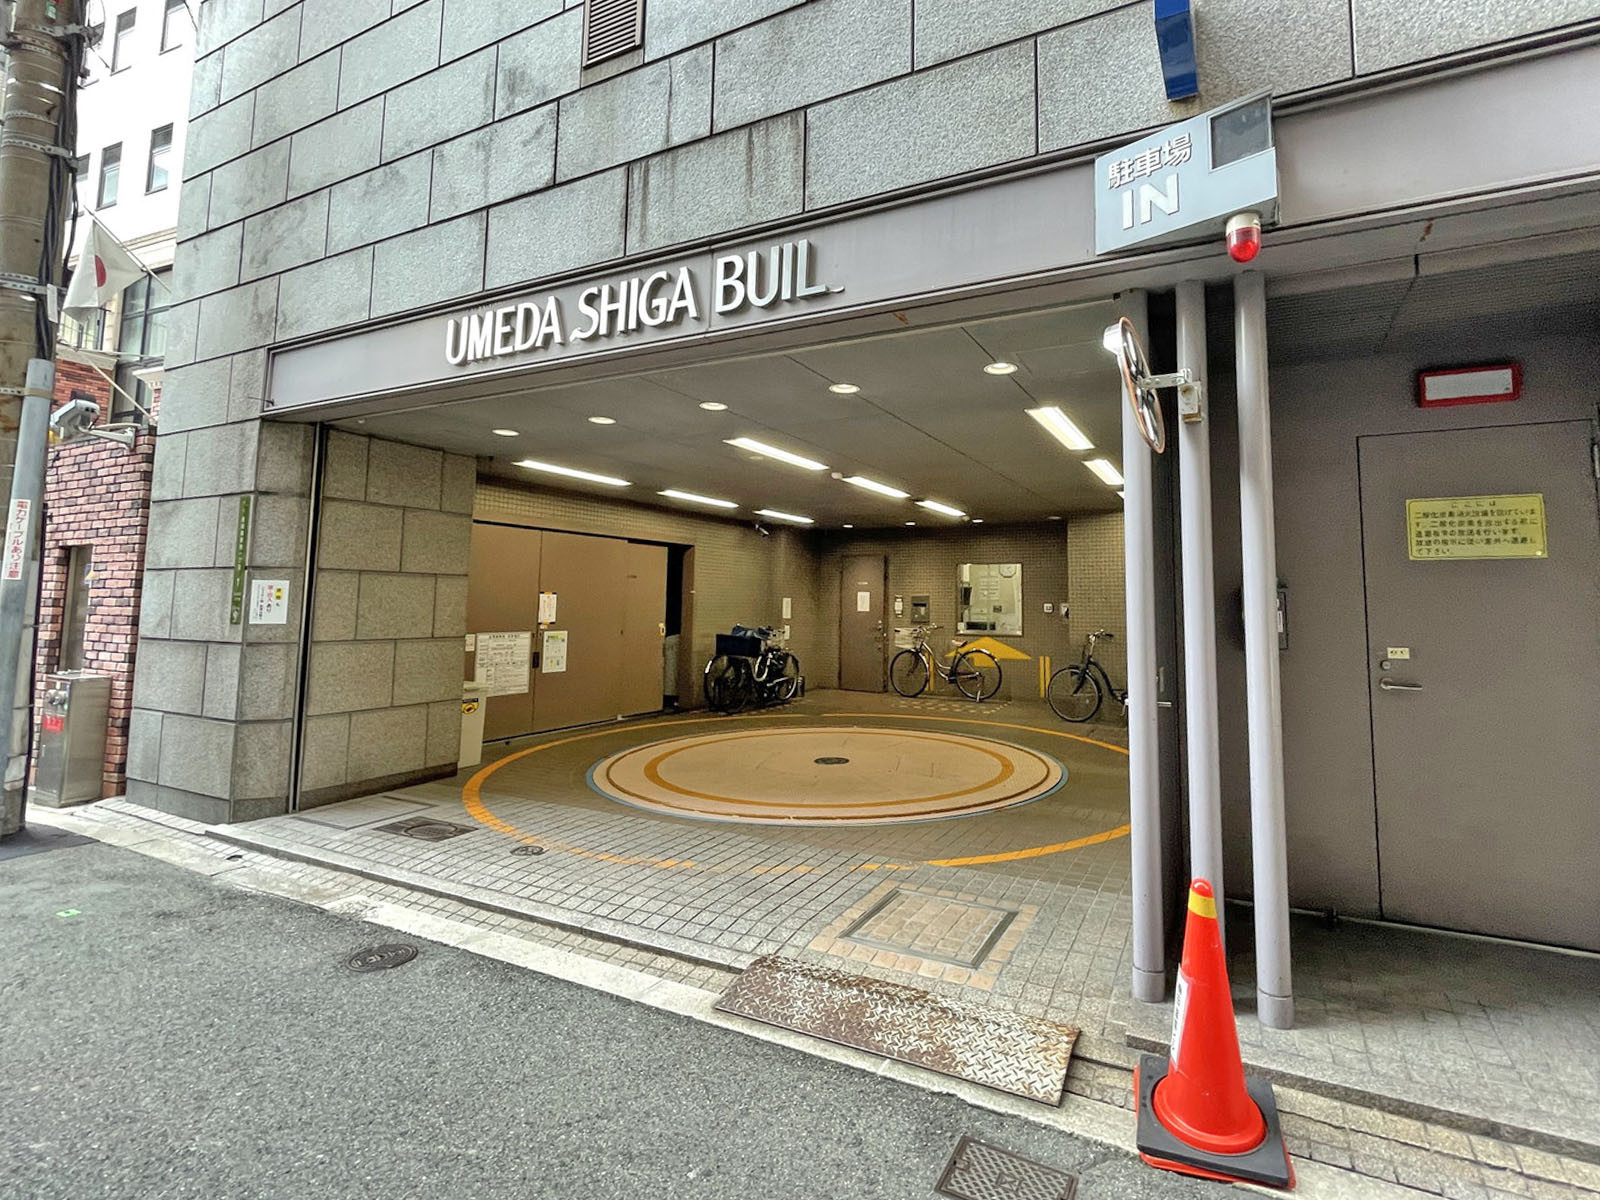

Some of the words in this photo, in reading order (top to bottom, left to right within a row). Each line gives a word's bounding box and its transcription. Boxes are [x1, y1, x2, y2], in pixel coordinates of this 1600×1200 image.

[1107, 132, 1193, 189] 駐車場
[1122, 172, 1180, 231] IN
[445, 294, 565, 367] UMEDA
[569, 266, 700, 343] SHIGA
